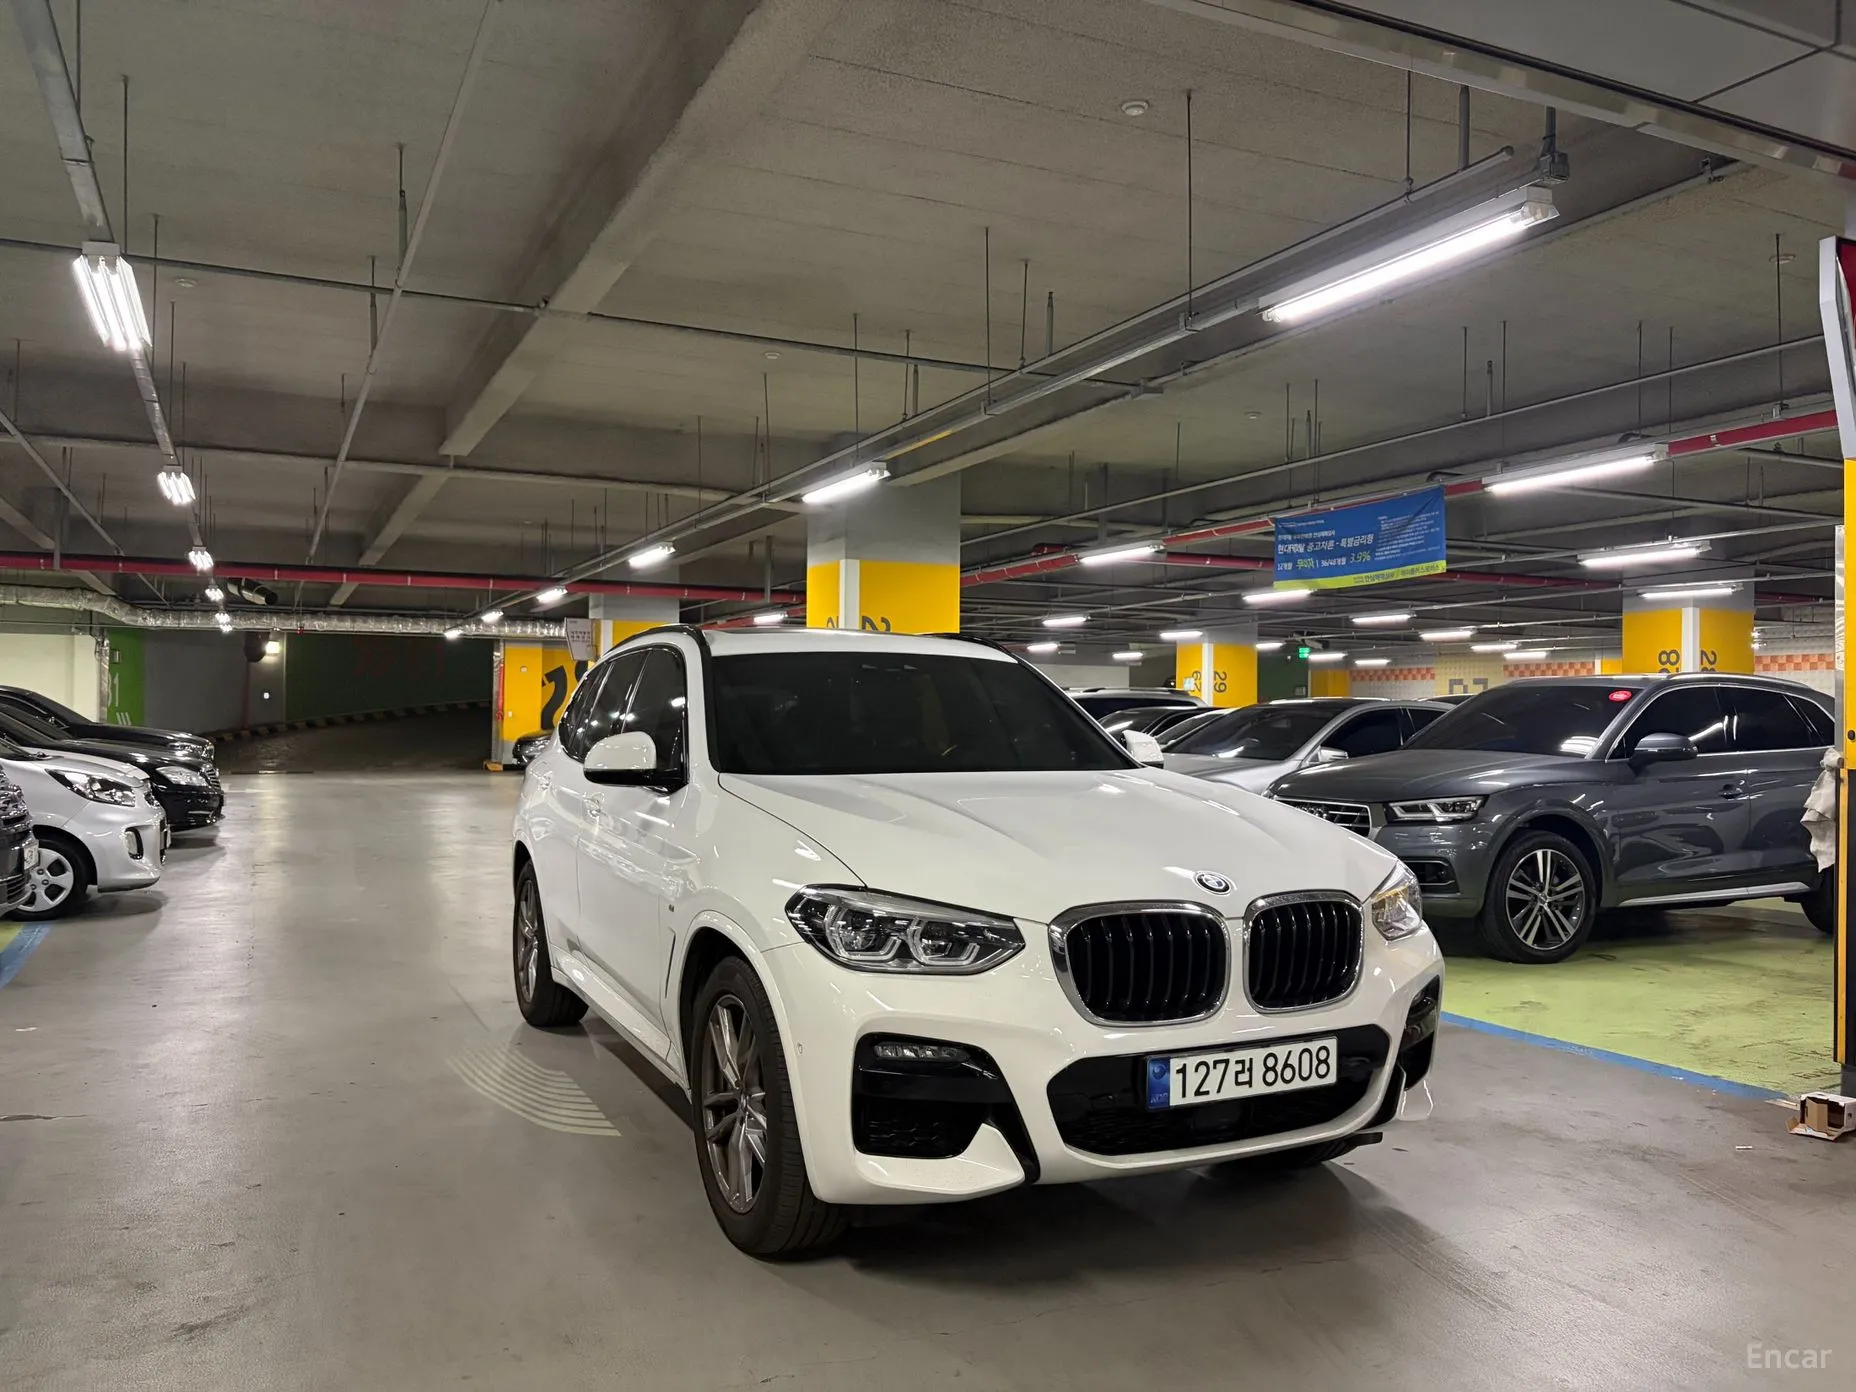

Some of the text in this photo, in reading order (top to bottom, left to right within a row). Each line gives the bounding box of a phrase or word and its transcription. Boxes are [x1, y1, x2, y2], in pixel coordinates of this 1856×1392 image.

[1350, 551, 1371, 564] 3.9%
[1213, 671, 1227, 694] 29
[1175, 1045, 1330, 1098] 127러 8608
